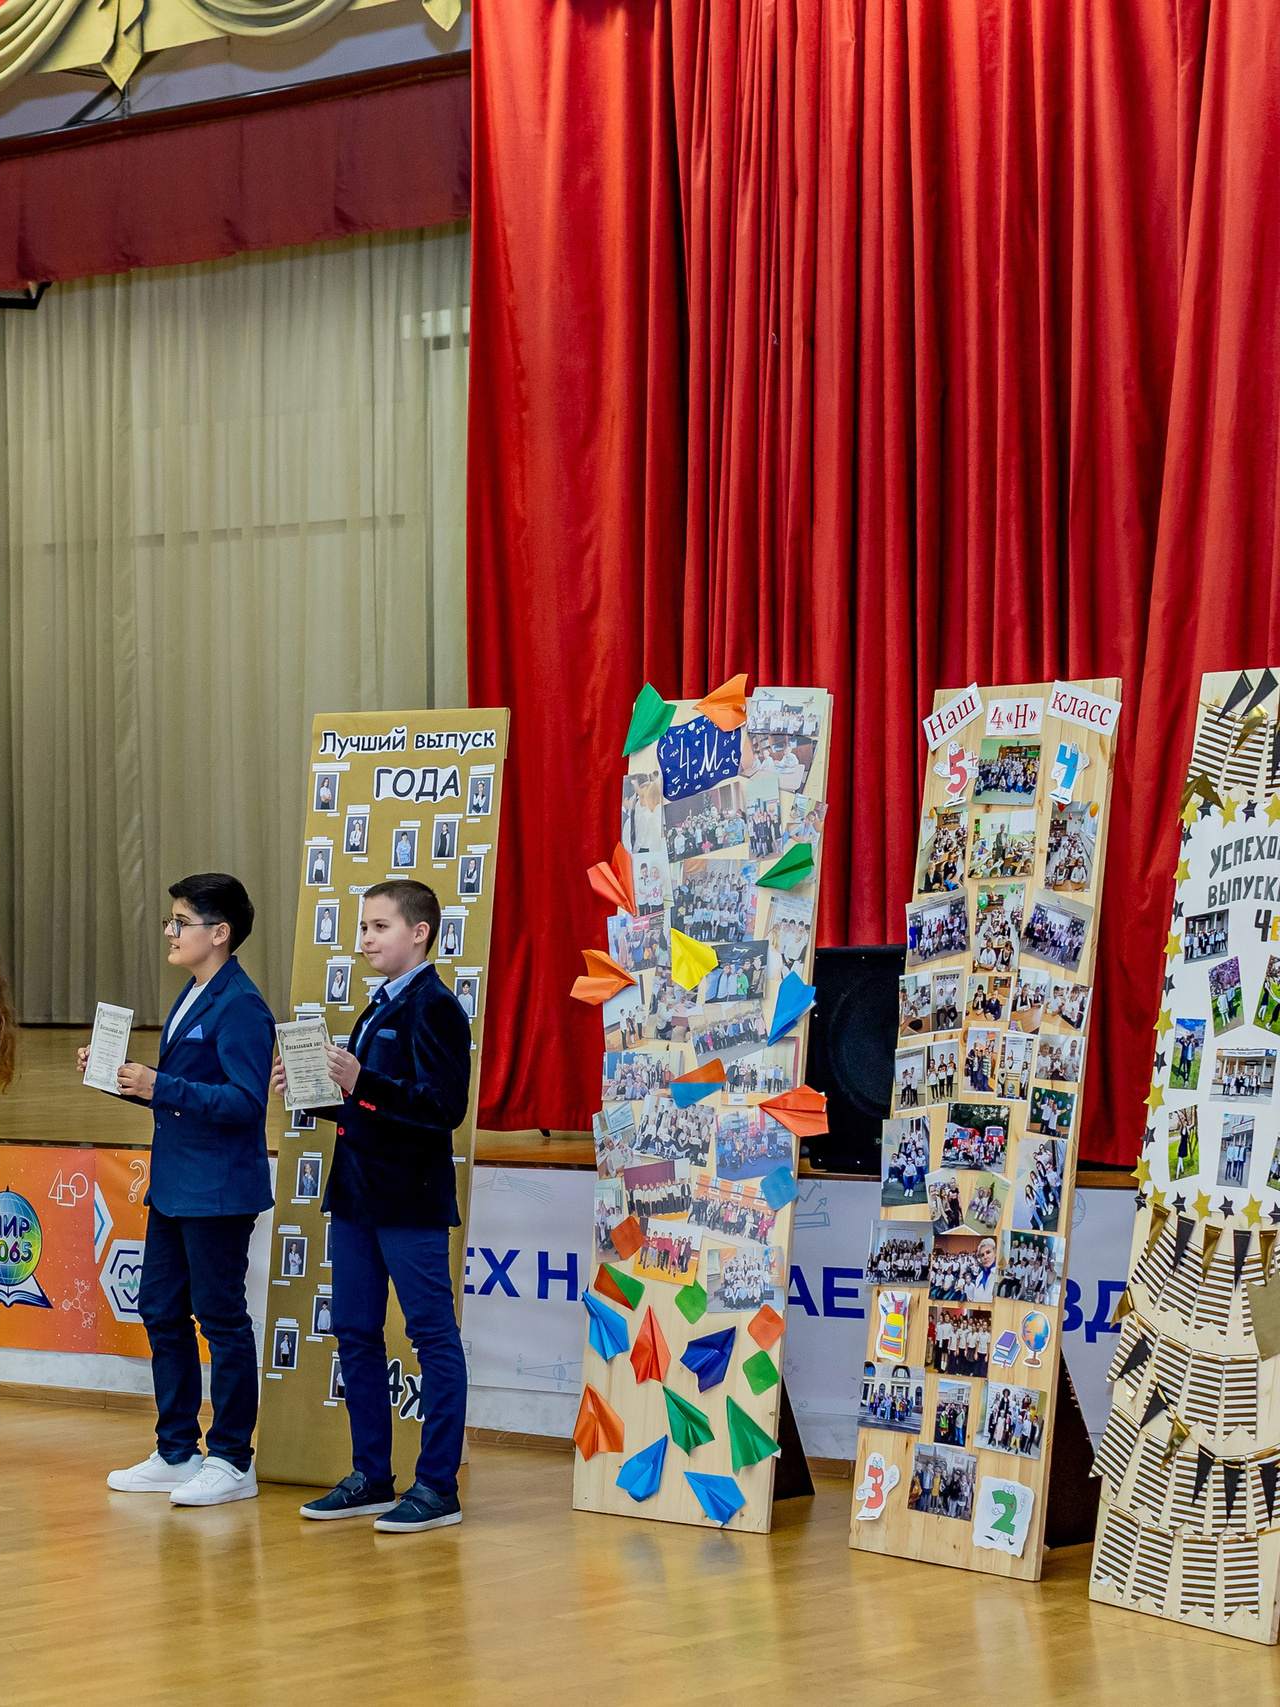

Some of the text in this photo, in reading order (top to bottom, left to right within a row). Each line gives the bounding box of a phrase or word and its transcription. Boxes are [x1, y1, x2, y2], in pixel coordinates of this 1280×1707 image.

[927, 695, 977, 741] Наш
[1051, 691, 1111, 726] класс
[320, 727, 495, 759] Лучший выпуск
[375, 768, 461, 802] ГОДА
[1209, 835, 1280, 879] УСПЕХО
[1208, 875, 1280, 908] ВЫПУСК
